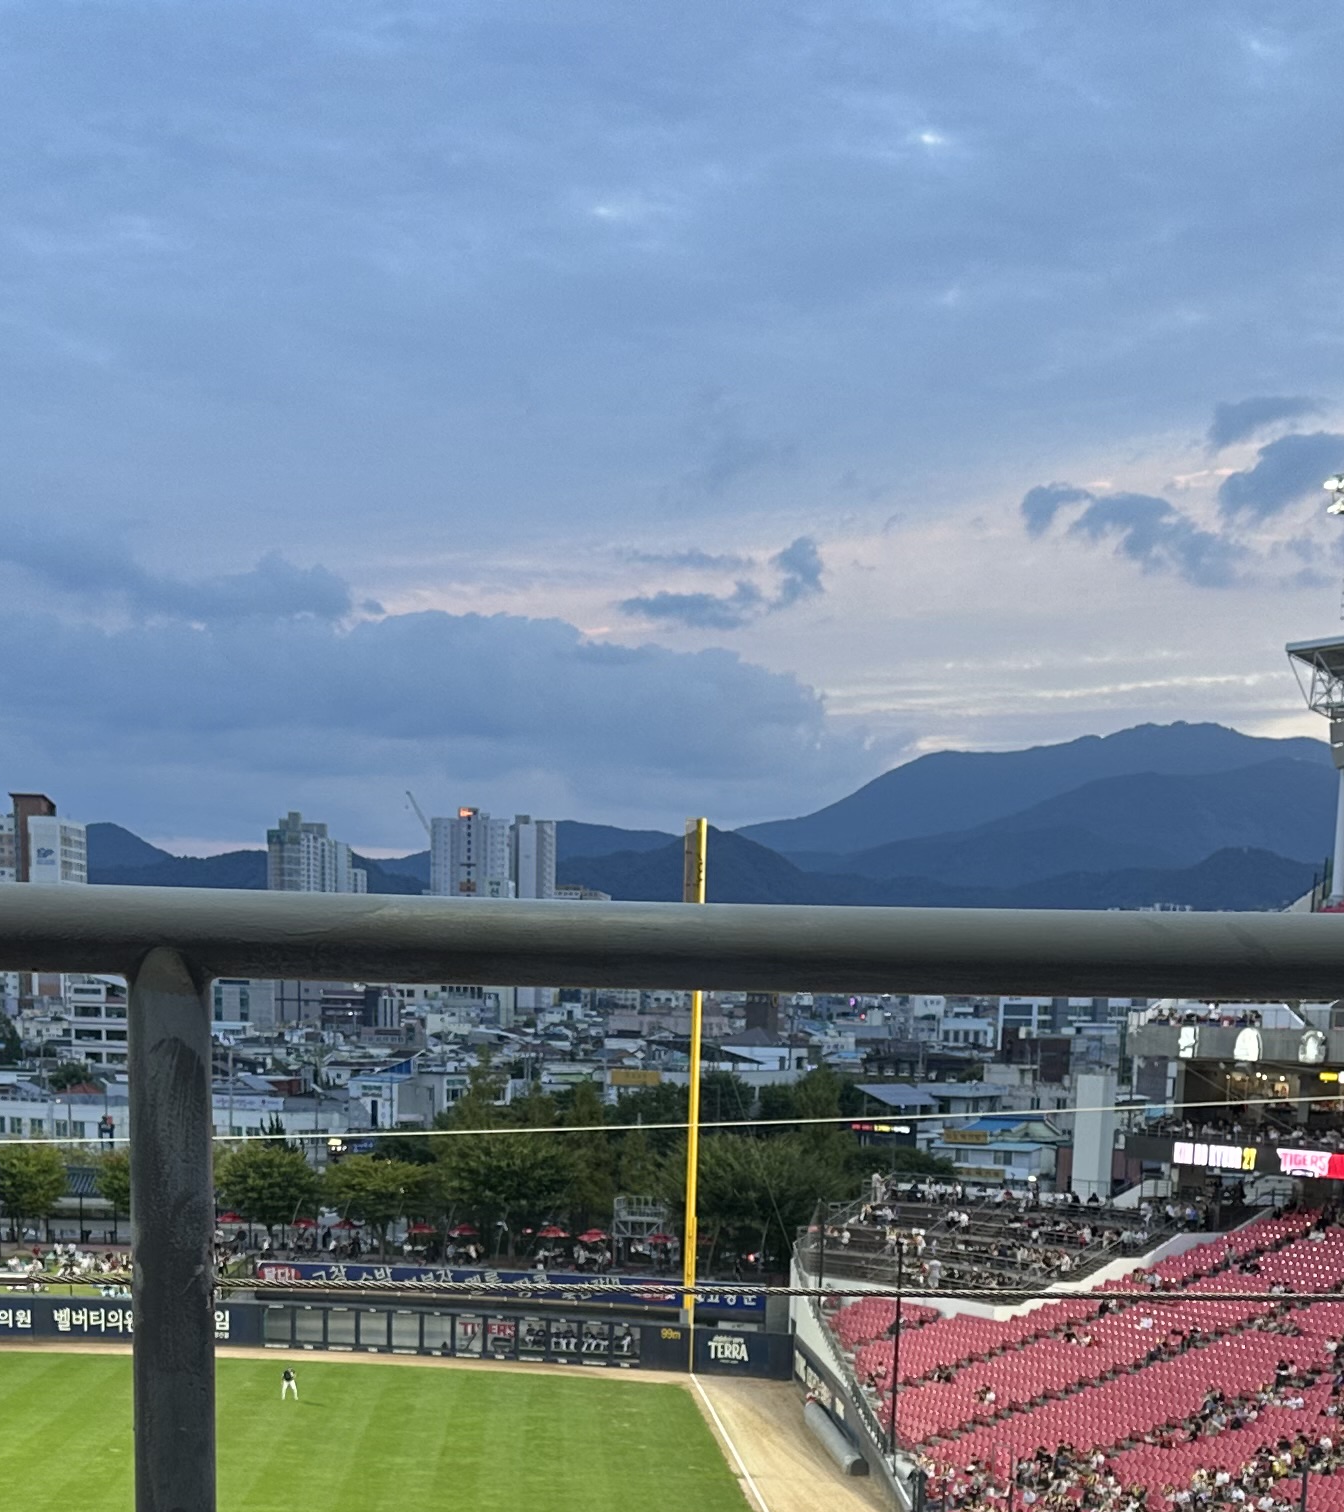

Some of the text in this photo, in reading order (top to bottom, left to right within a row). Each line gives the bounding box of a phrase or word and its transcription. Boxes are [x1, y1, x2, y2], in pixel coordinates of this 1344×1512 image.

[1280, 1152, 1327, 1174] TIGERS
[459, 1321, 516, 1338] TIERS
[661, 1327, 681, 1340] 99m
[708, 1340, 749, 1362] TERRA
